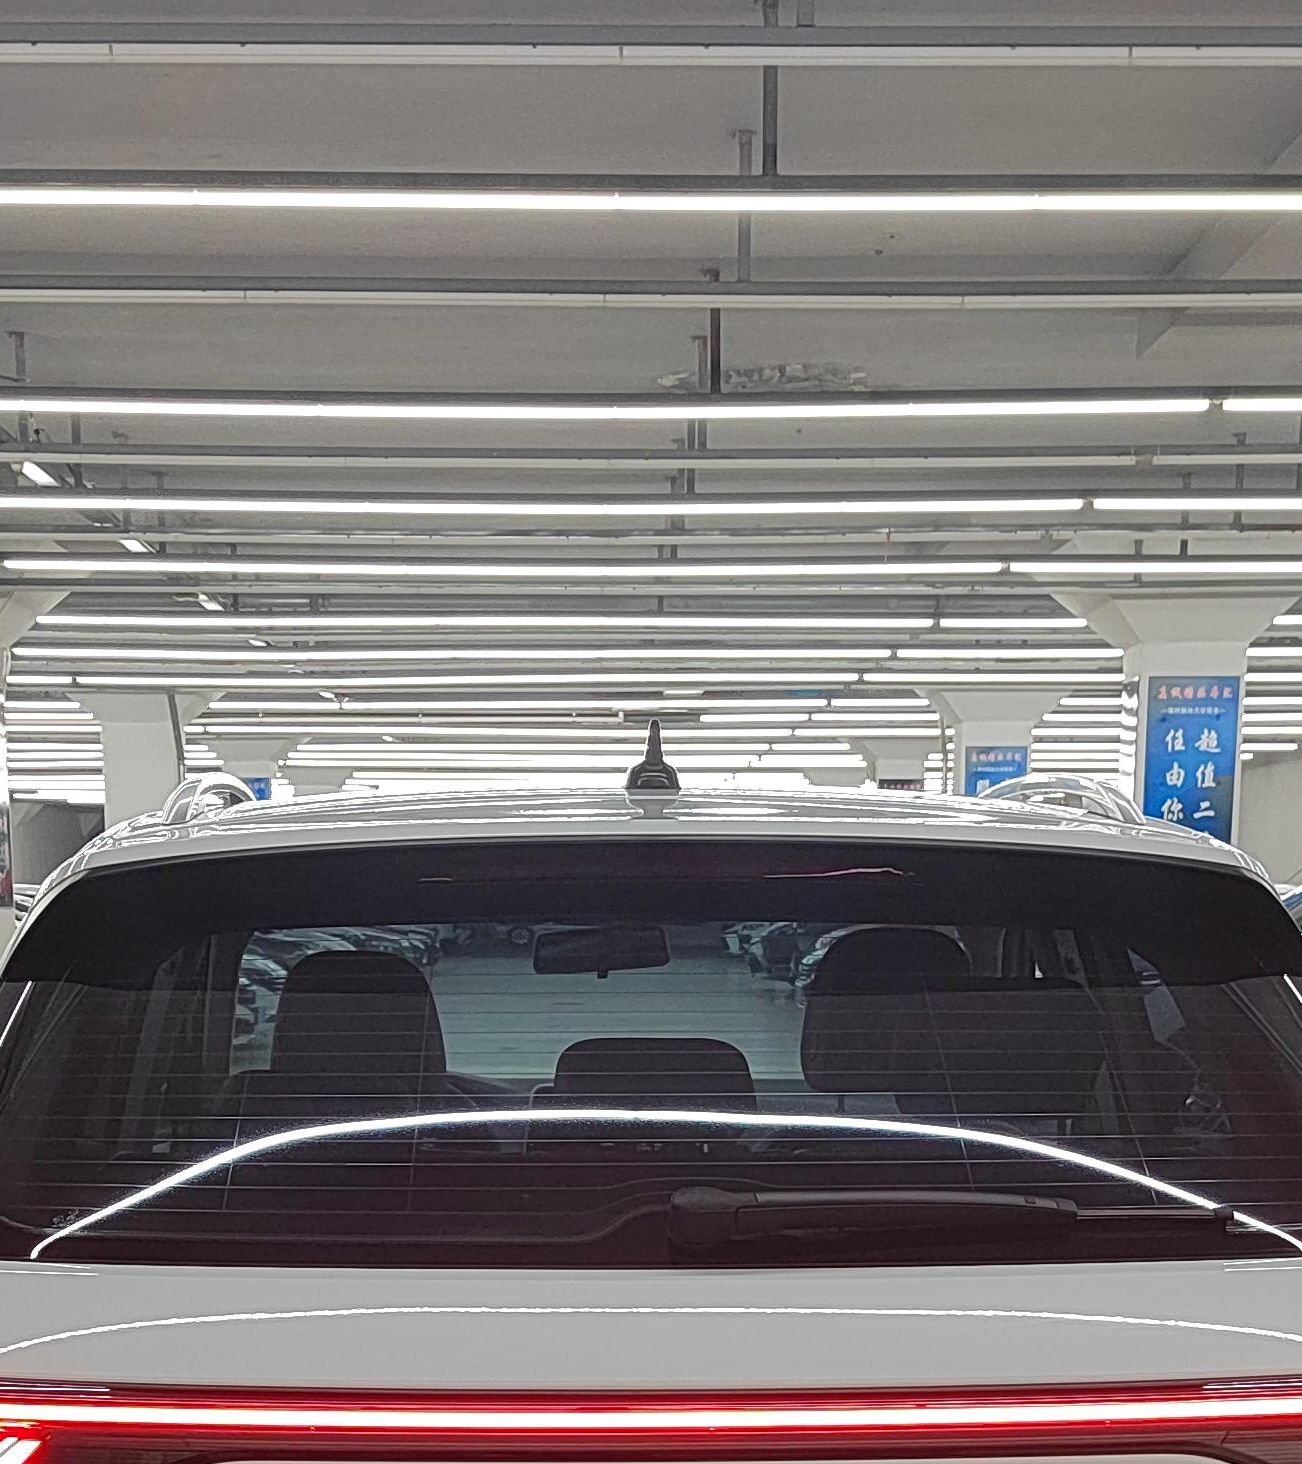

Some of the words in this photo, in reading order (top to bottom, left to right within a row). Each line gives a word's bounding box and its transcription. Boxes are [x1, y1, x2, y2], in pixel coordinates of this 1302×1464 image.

[1161, 728, 1186, 821] 任由你
[1193, 728, 1221, 834] 超值二
